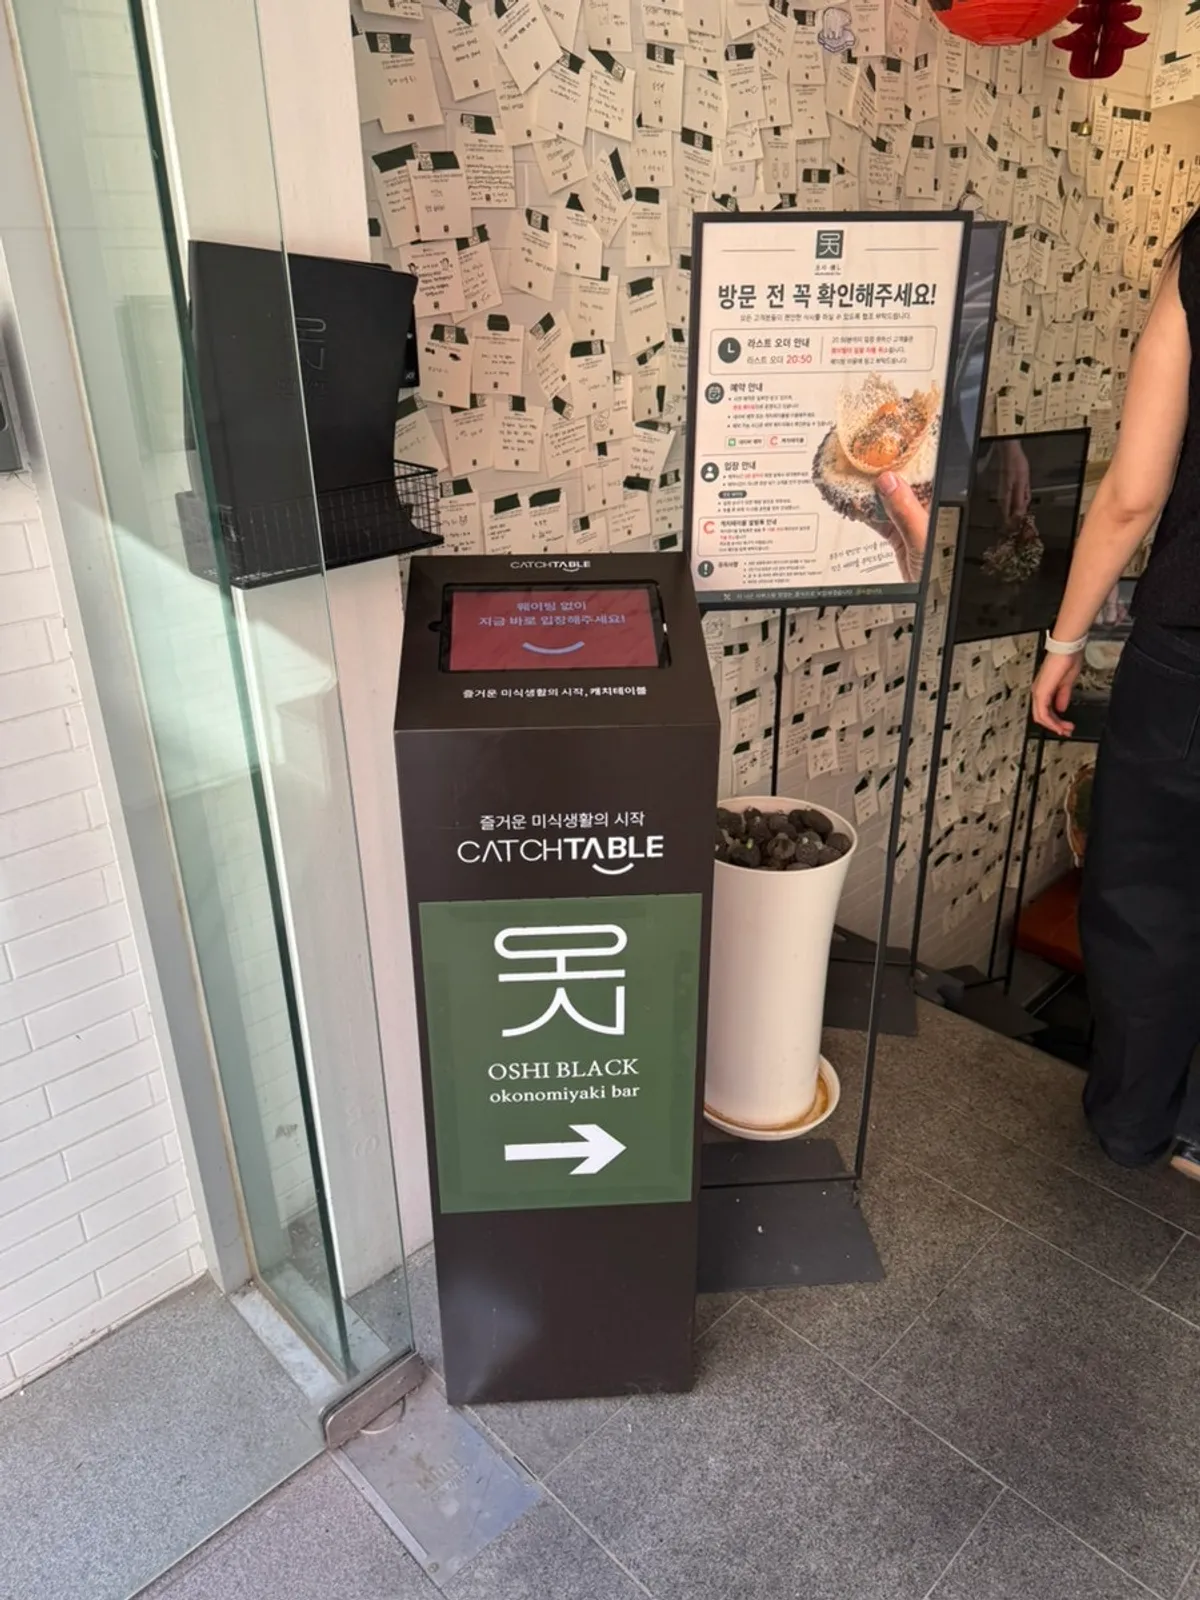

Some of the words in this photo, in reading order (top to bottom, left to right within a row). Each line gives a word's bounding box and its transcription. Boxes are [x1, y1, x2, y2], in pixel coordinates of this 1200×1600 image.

[718, 284, 757, 310] 방문
[766, 284, 785, 309] 전
[792, 285, 812, 309] 꼭
[816, 282, 937, 309] 확인해주세요!
[747, 338, 771, 348] 라스트
[775, 338, 791, 348] 오더
[793, 337, 810, 347] 안내
[747, 355, 767, 364] 라스트
[770, 355, 783, 364] 오더
[786, 354, 812, 364] 20:50
[730, 382, 746, 393] 예약
[748, 382, 763, 392] 안내
[724, 461, 739, 471] 입장
[742, 461, 756, 470] 안내
[510, 560, 591, 570] CATCHTABLE
[516, 601, 556, 613] 웨이팅
[560, 600, 587, 612] 없이
[478, 616, 505, 627] 지금
[509, 616, 536, 627] 바로
[540, 614, 626, 626] 입장해주세요!
[463, 687, 498, 699] 즐거운
[501, 687, 559, 699] 미식생활의
[562, 687, 588, 698] 시작,
[590, 686, 648, 697] 캐치테이블
[480, 814, 527, 831] 즐거운
[532, 812, 609, 829] 미식생활의
[614, 811, 645, 827] 시작
[457, 835, 664, 864] CATCHTABLE
[488, 1062, 550, 1081] OSHI
[556, 1058, 639, 1079] BLACK
[489, 1085, 606, 1104] okonomiyaki
[611, 1084, 640, 1099] bar
